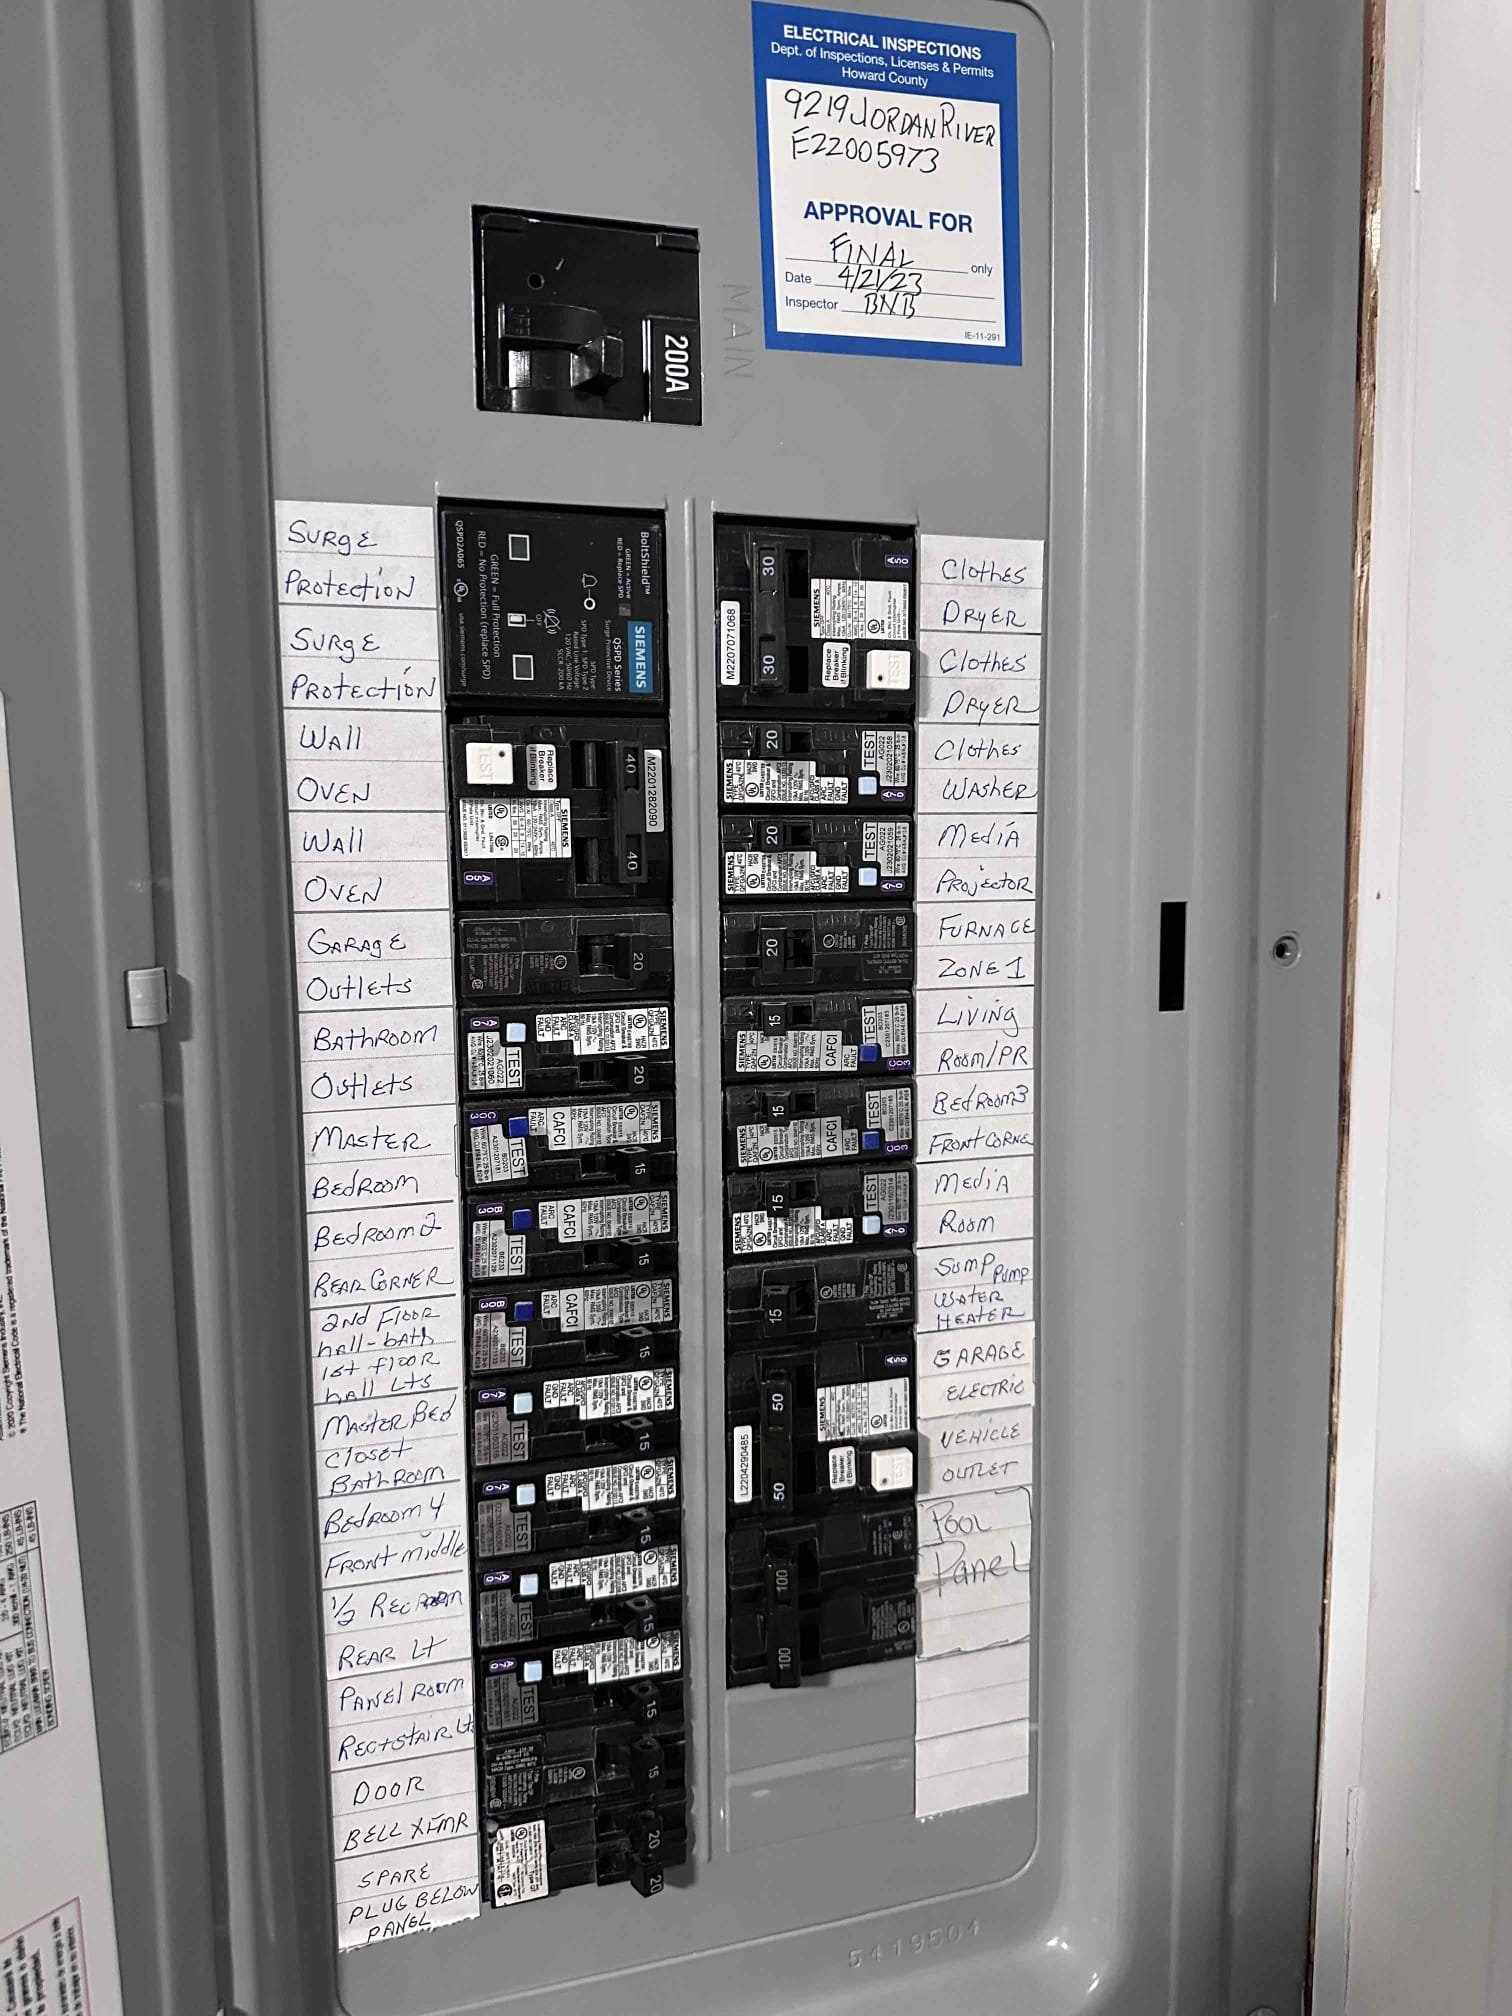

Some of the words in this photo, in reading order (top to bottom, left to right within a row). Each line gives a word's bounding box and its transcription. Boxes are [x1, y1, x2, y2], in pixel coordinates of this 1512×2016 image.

[783, 25, 878, 49] ELECTRICAL
[882, 36, 981, 60] INSPECTIONS
[771, 42, 802, 58] Dept.
[806, 47, 817, 57] of
[820, 48, 887, 67] Inspections,
[891, 56, 939, 71] Licenses
[943, 62, 950, 72] &
[954, 63, 994, 78] Permits
[842, 67, 886, 83] Howard
[889, 72, 928, 88] County
[785, 88, 848, 123] 9219
[804, 201, 923, 228] APPROVAL
[929, 212, 973, 233] FOR
[830, 233, 914, 267] FINAL
[785, 272, 811, 284] Date
[971, 264, 993, 276] only
[838, 268, 922, 295] 4/21/23
[785, 296, 838, 312] Inspector
[721, 284, 754, 379] MAIN
[965, 332, 1000, 342] IE-11-291
[664, 334, 690, 393] 200A
[456, 520, 465, 569] QSPD2A065
[478, 530, 486, 549] RED
[479, 559, 487, 572] No
[490, 554, 499, 585] GREEN
[762, 556, 775, 576] 30
[479, 574, 487, 619] Protection
[492, 593, 500, 610] Full
[480, 621, 490, 657] (replace
[492, 611, 500, 658] Protection
[727, 608, 736, 680] M2207071068
[634, 625, 646, 689] SIEMENS
[762, 655, 775, 674] 30
[481, 659, 491, 680] SPD)
[767, 730, 777, 749] 20
[625, 753, 637, 774] 40
[647, 756, 658, 827] M2201282090
[767, 826, 778, 845] 20
[627, 851, 637, 871] 40
[767, 939, 777, 957] 20
[633, 952, 644, 971] 20
[1006, 957, 1026, 978] 1
[769, 1015, 781, 1027] 15
[826, 1034, 838, 1066] CAFCI
[633, 1066, 644, 1085] 20
[773, 1106, 784, 1116] 15
[553, 1112, 566, 1146] CAFCI
[634, 1163, 645, 1175] 15
[773, 1195, 783, 1211] 15
[563, 1205, 576, 1238] CAFCI
[638, 1253, 649, 1266] 15
[566, 1294, 578, 1328] CAFCI
[769, 1308, 782, 1323] 15
[639, 1346, 650, 1358] 15
[933, 1341, 1025, 1367] GARAGE
[772, 1393, 783, 1411] 50
[639, 1433, 650, 1451] 15
[942, 1461, 1018, 1482] OUTLET
[773, 1483, 785, 1501] 50
[430, 1492, 445, 1519] 4
[640, 1527, 651, 1544] 15
[776, 1570, 788, 1592] 100
[643, 1615, 655, 1632] 15
[779, 1648, 790, 1669] 100
[647, 1701, 657, 1718] 15
[648, 1765, 659, 1778] 15
[353, 1776, 425, 1805] DOOR
[343, 1822, 402, 1852] BELL
[411, 1812, 468, 1839] XFMR
[648, 1831, 660, 1848] 20
[358, 1863, 431, 1888] SPARE
[650, 1875, 662, 1893] 20
[349, 1895, 408, 1924] PLUG
[416, 1883, 479, 1908] BELOW
[368, 1911, 431, 1943] PANEL
